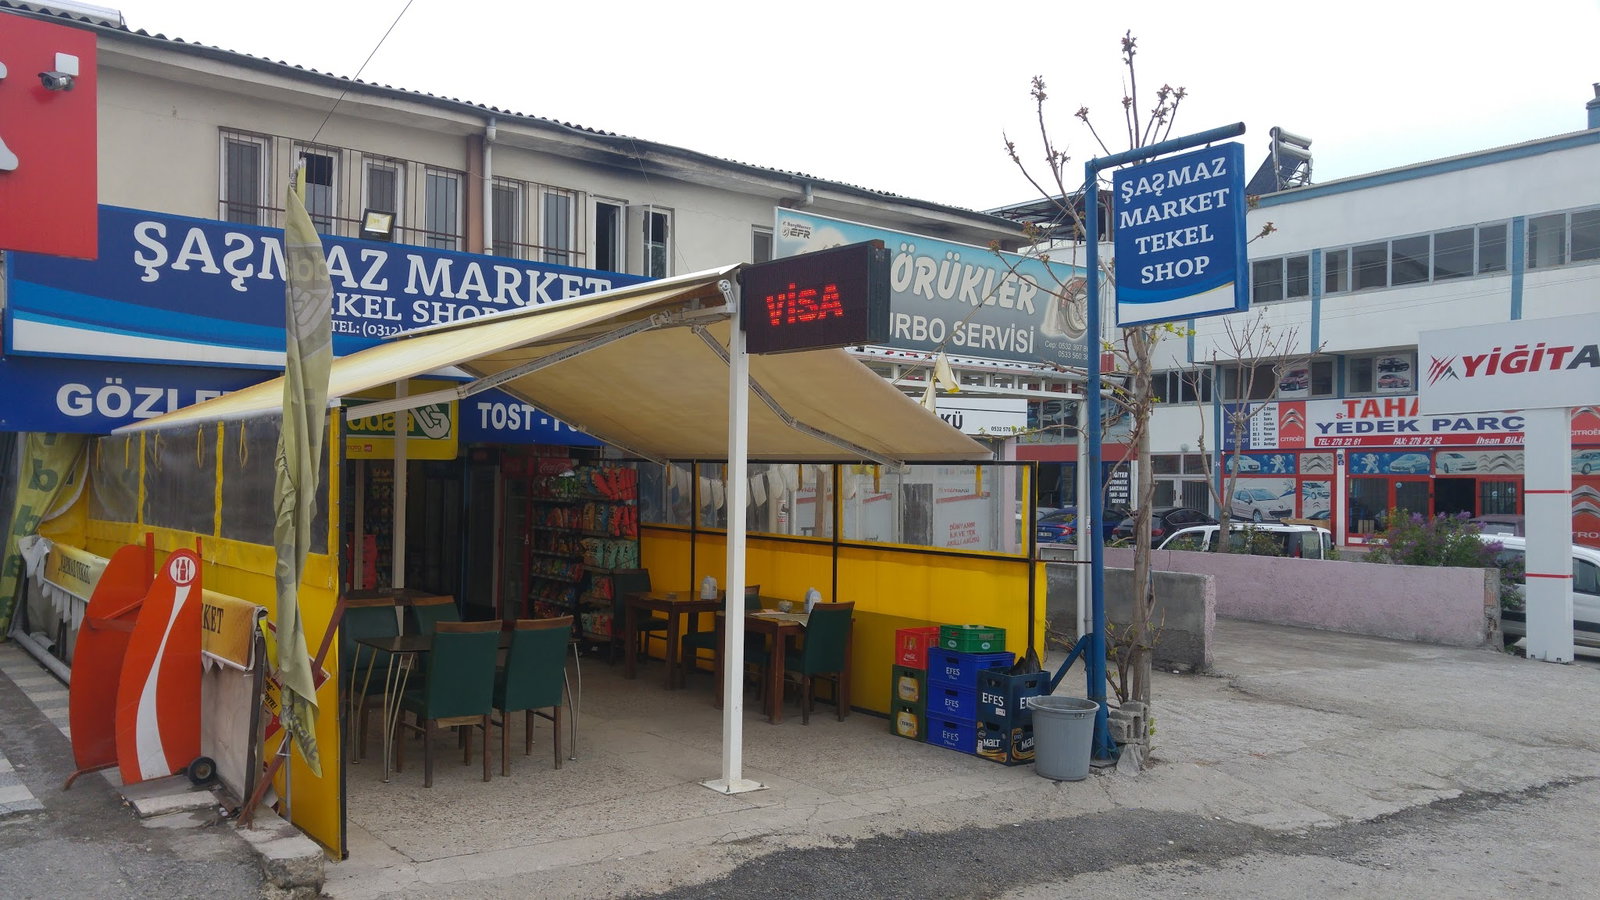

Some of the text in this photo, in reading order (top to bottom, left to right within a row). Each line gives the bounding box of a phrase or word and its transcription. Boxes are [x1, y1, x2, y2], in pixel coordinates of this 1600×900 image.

[1119, 187, 1230, 229] MARKET
[1135, 224, 1214, 255] TEKEL
[1141, 255, 1210, 285] SHOP
[890, 312, 1034, 354] RBO SERVİSİ
[477, 402, 535, 430] TOST
[1315, 419, 1420, 434] YEDEK
[945, 667, 961, 676] EFES
[944, 698, 960, 708] EFES
[982, 692, 1004, 707] EFES
[942, 730, 960, 742] EFES
